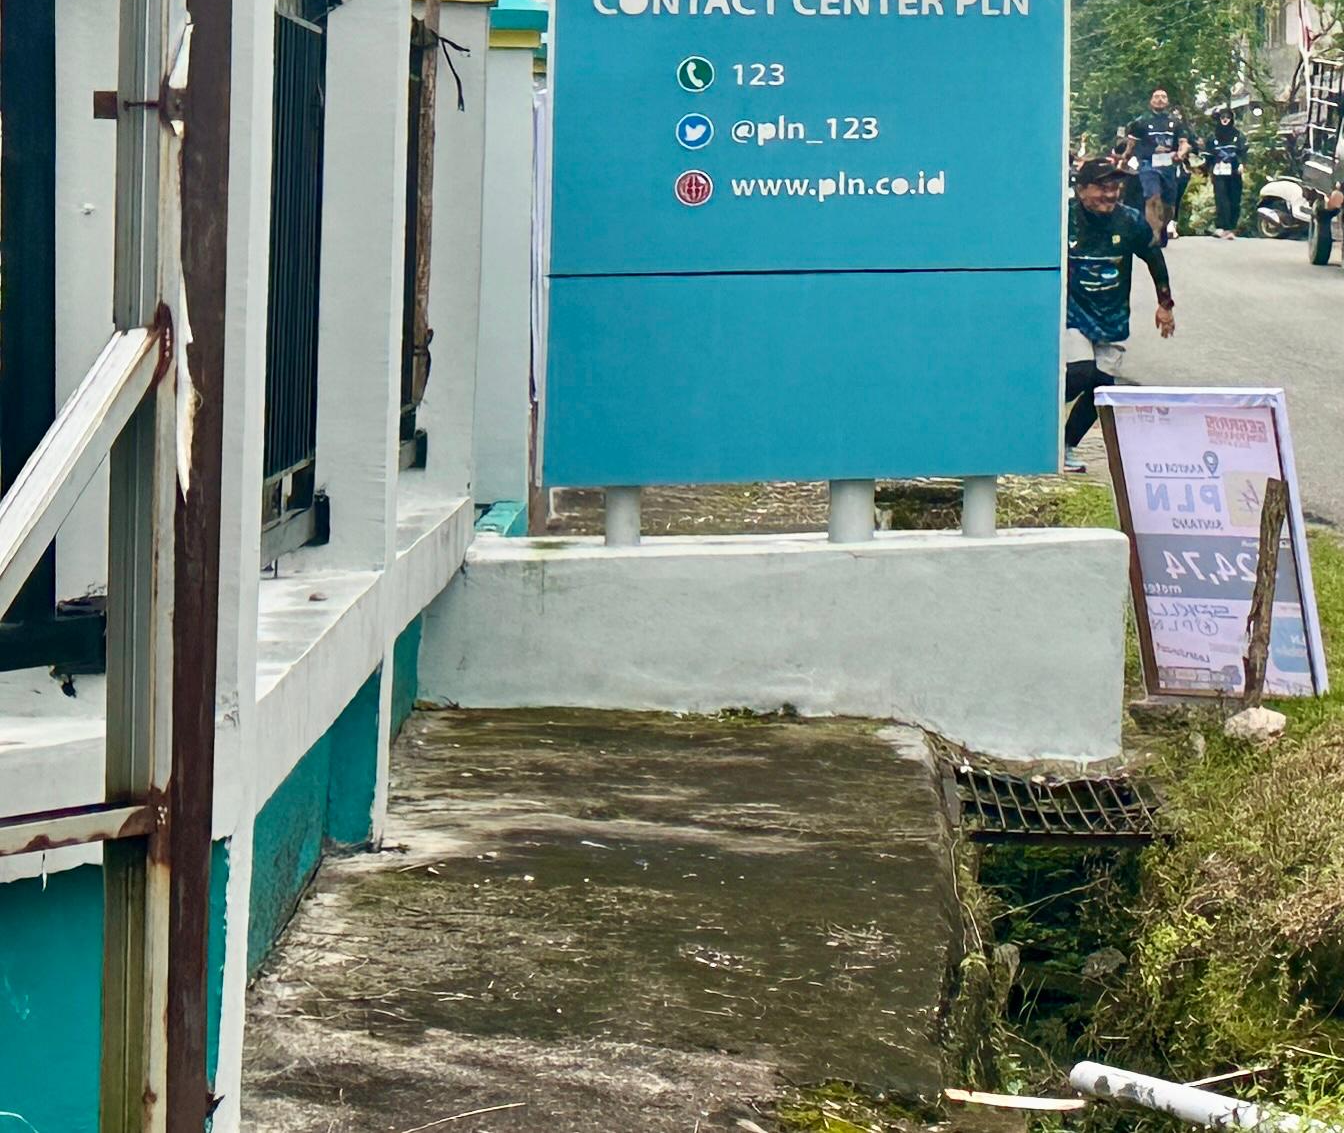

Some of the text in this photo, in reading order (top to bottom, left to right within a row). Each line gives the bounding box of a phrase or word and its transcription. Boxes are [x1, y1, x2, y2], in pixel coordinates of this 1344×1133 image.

[733, 64, 785, 87] 123
[731, 116, 879, 145] @pln_123
[731, 171, 946, 202] www.pln.co.id
